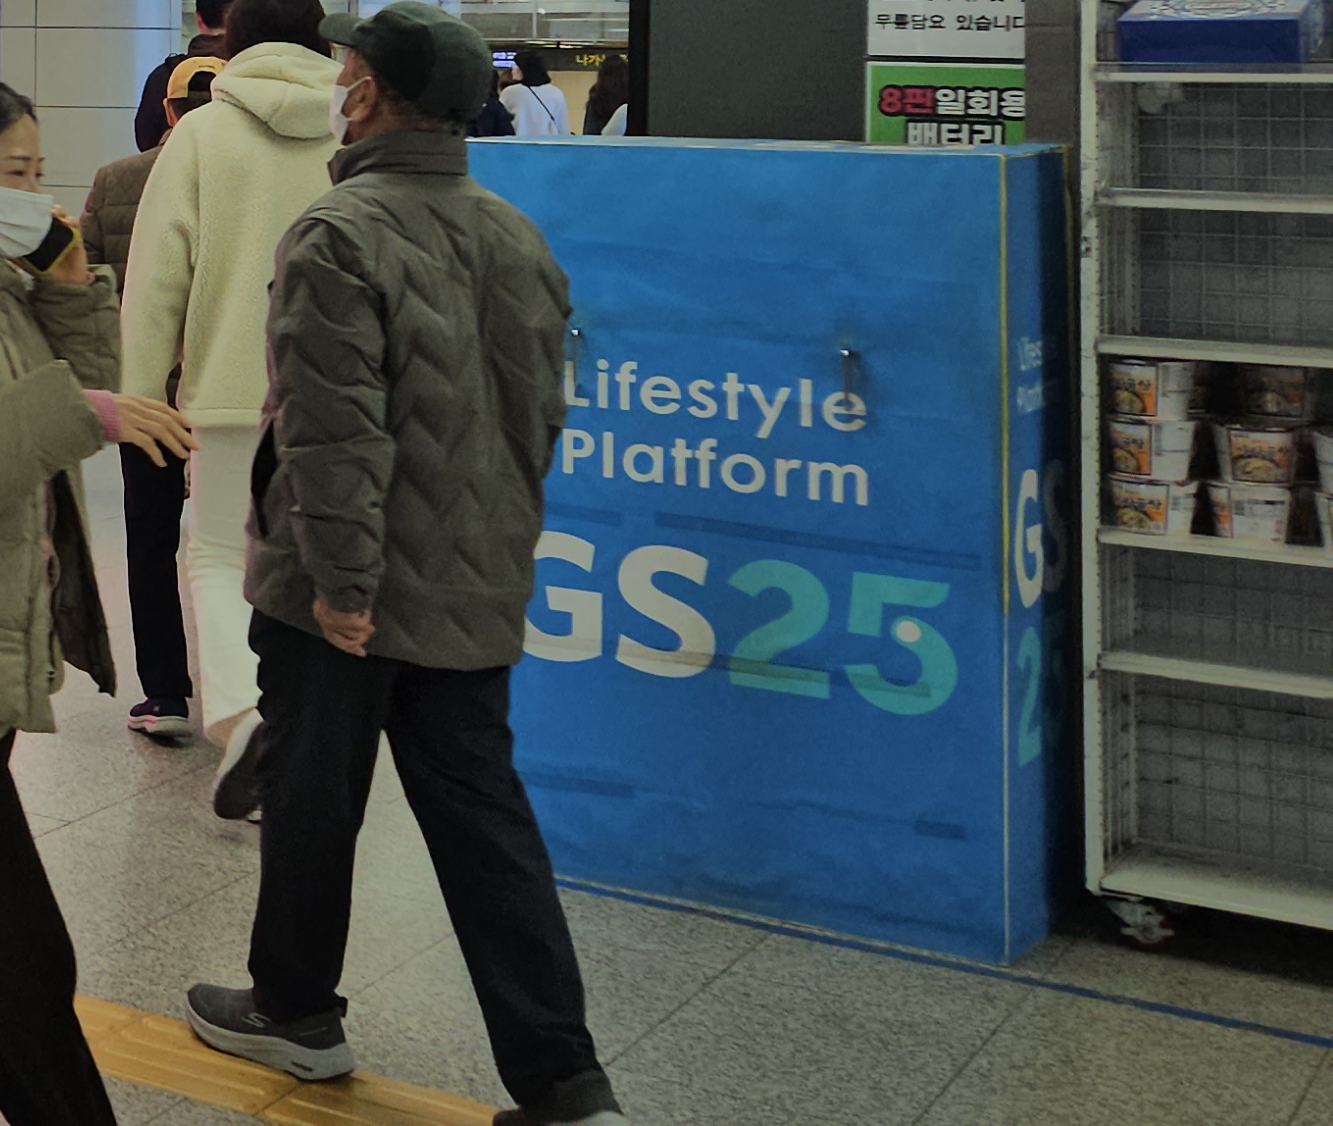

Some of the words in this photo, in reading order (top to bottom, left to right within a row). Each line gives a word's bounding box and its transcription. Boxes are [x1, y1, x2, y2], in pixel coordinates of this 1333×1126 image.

[875, 14, 946, 31] 무릎담요
[907, 122, 1003, 145] 배터리
[564, 358, 868, 440] Lifestyle
[561, 428, 870, 506] Platform
[523, 530, 959, 716] GS25
